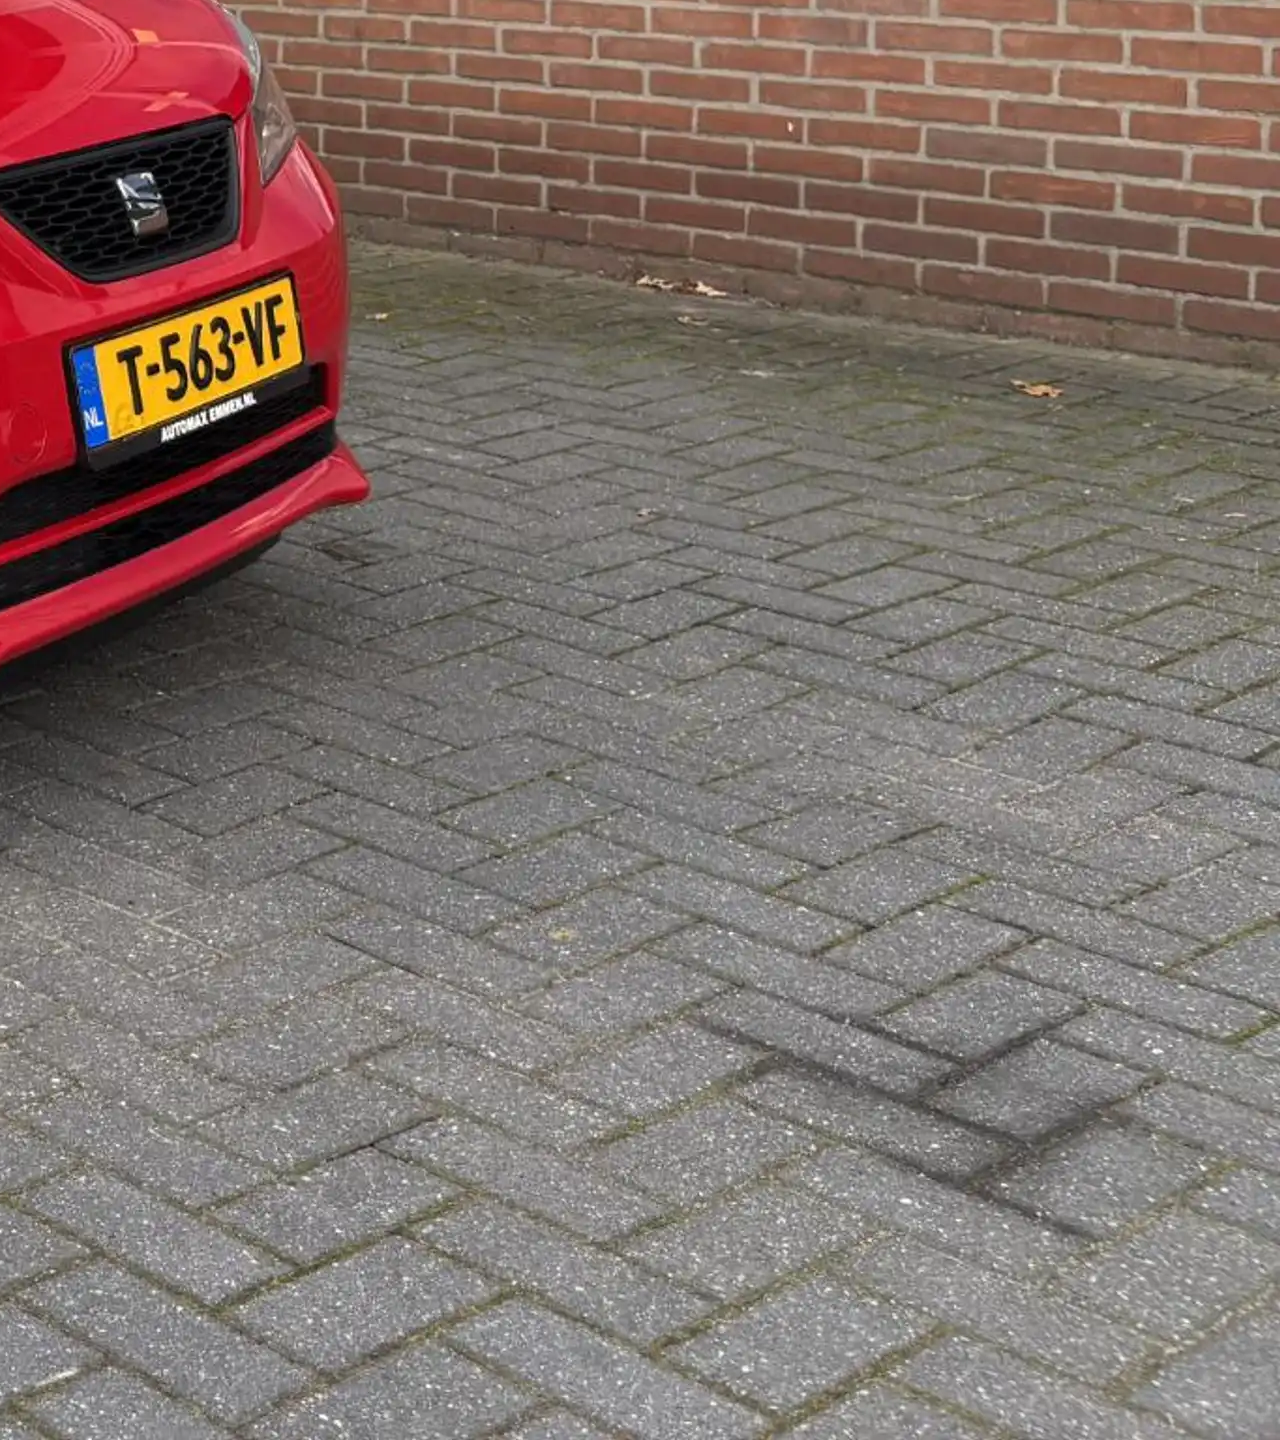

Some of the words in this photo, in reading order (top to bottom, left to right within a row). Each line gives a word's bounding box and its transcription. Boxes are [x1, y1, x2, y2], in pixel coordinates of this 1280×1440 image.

[116, 294, 285, 415] T-563-VF
[84, 408, 103, 431] NL
[160, 414, 208, 443] AUTOMAX
[209, 391, 257, 423] EMMEN.NL
